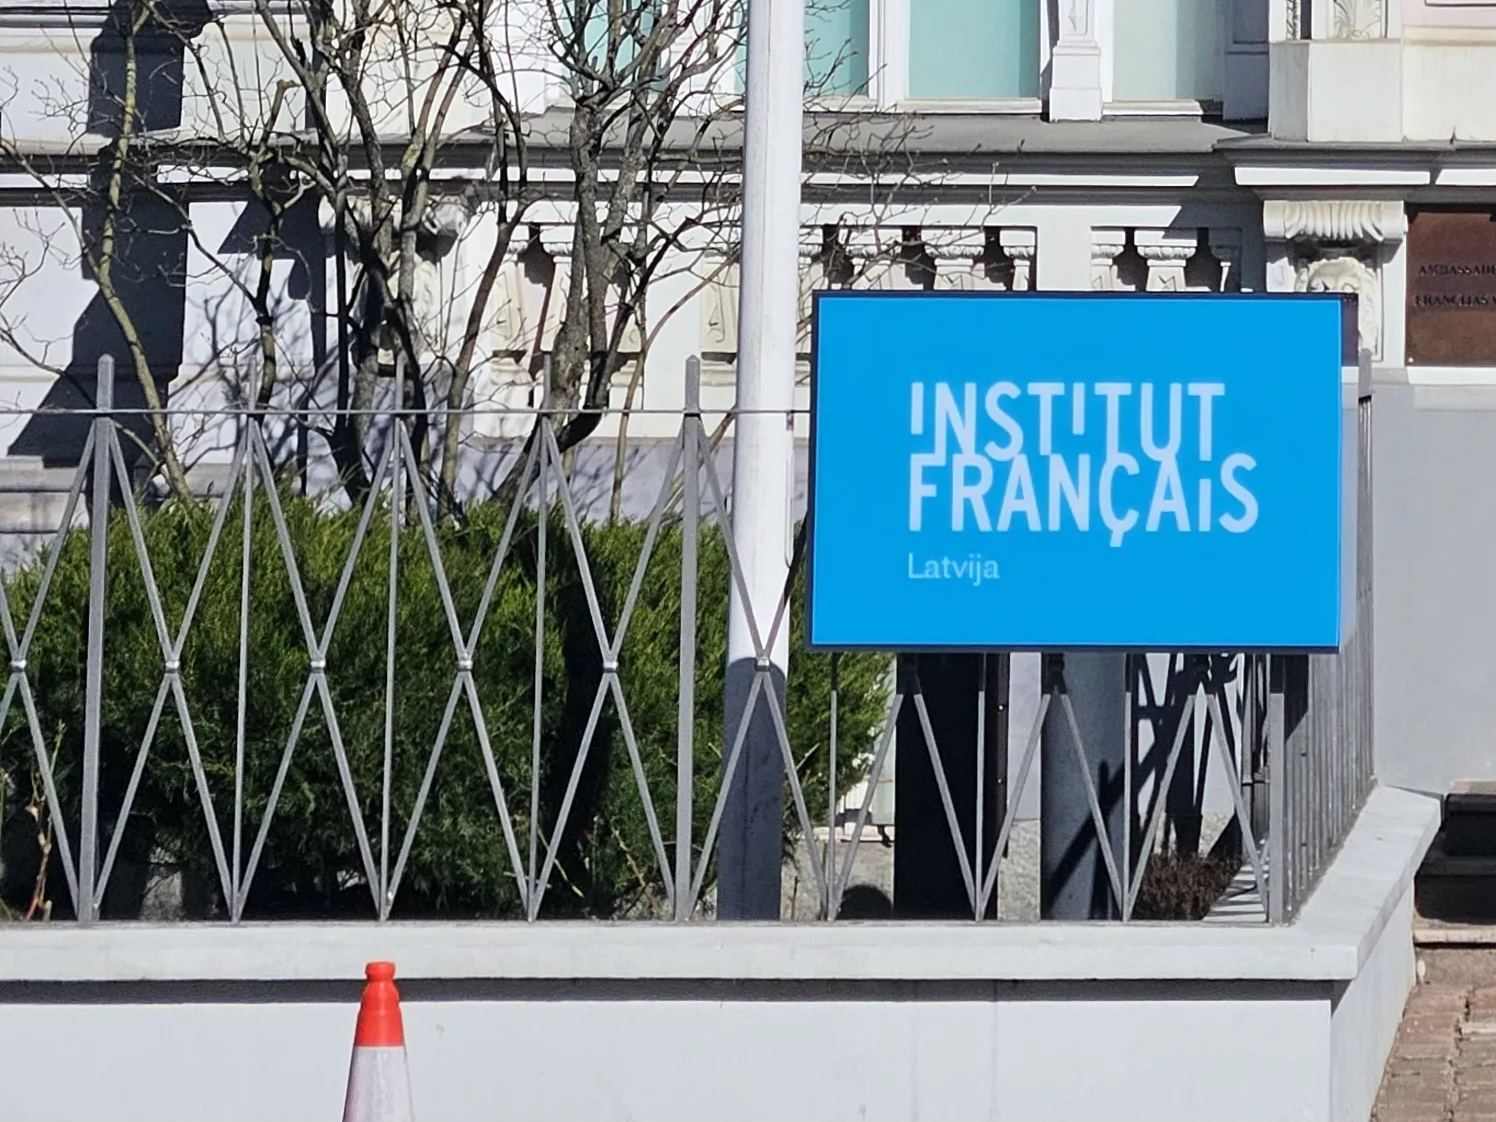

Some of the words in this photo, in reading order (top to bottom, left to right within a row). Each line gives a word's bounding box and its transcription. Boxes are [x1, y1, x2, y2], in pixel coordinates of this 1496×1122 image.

[909, 381, 1226, 466] INSTITUT
[909, 453, 1259, 548] FRANÇAIS
[908, 552, 1001, 587] Latvija
